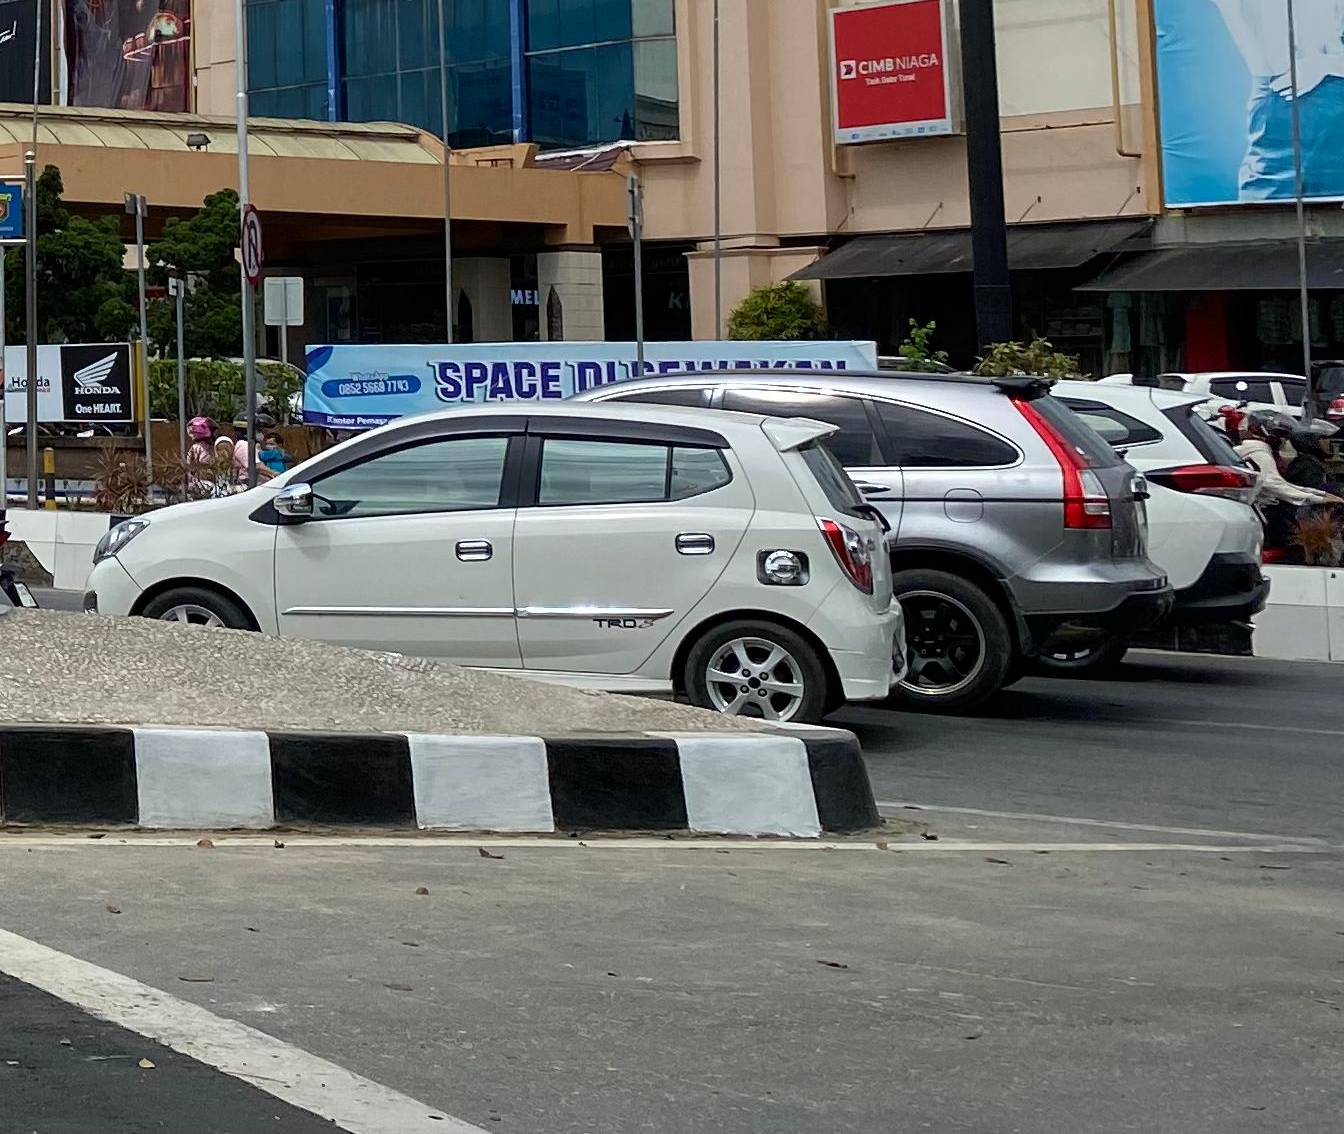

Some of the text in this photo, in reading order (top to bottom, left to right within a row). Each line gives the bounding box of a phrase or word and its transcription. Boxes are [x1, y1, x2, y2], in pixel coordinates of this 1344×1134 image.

[858, 53, 939, 75] CIMB NIAGA
[12, 376, 50, 387] Hoda
[434, 360, 562, 403] SPACE
[74, 387, 121, 395] HONDA
[339, 382, 362, 395] 0852
[76, 403, 92, 414] One
